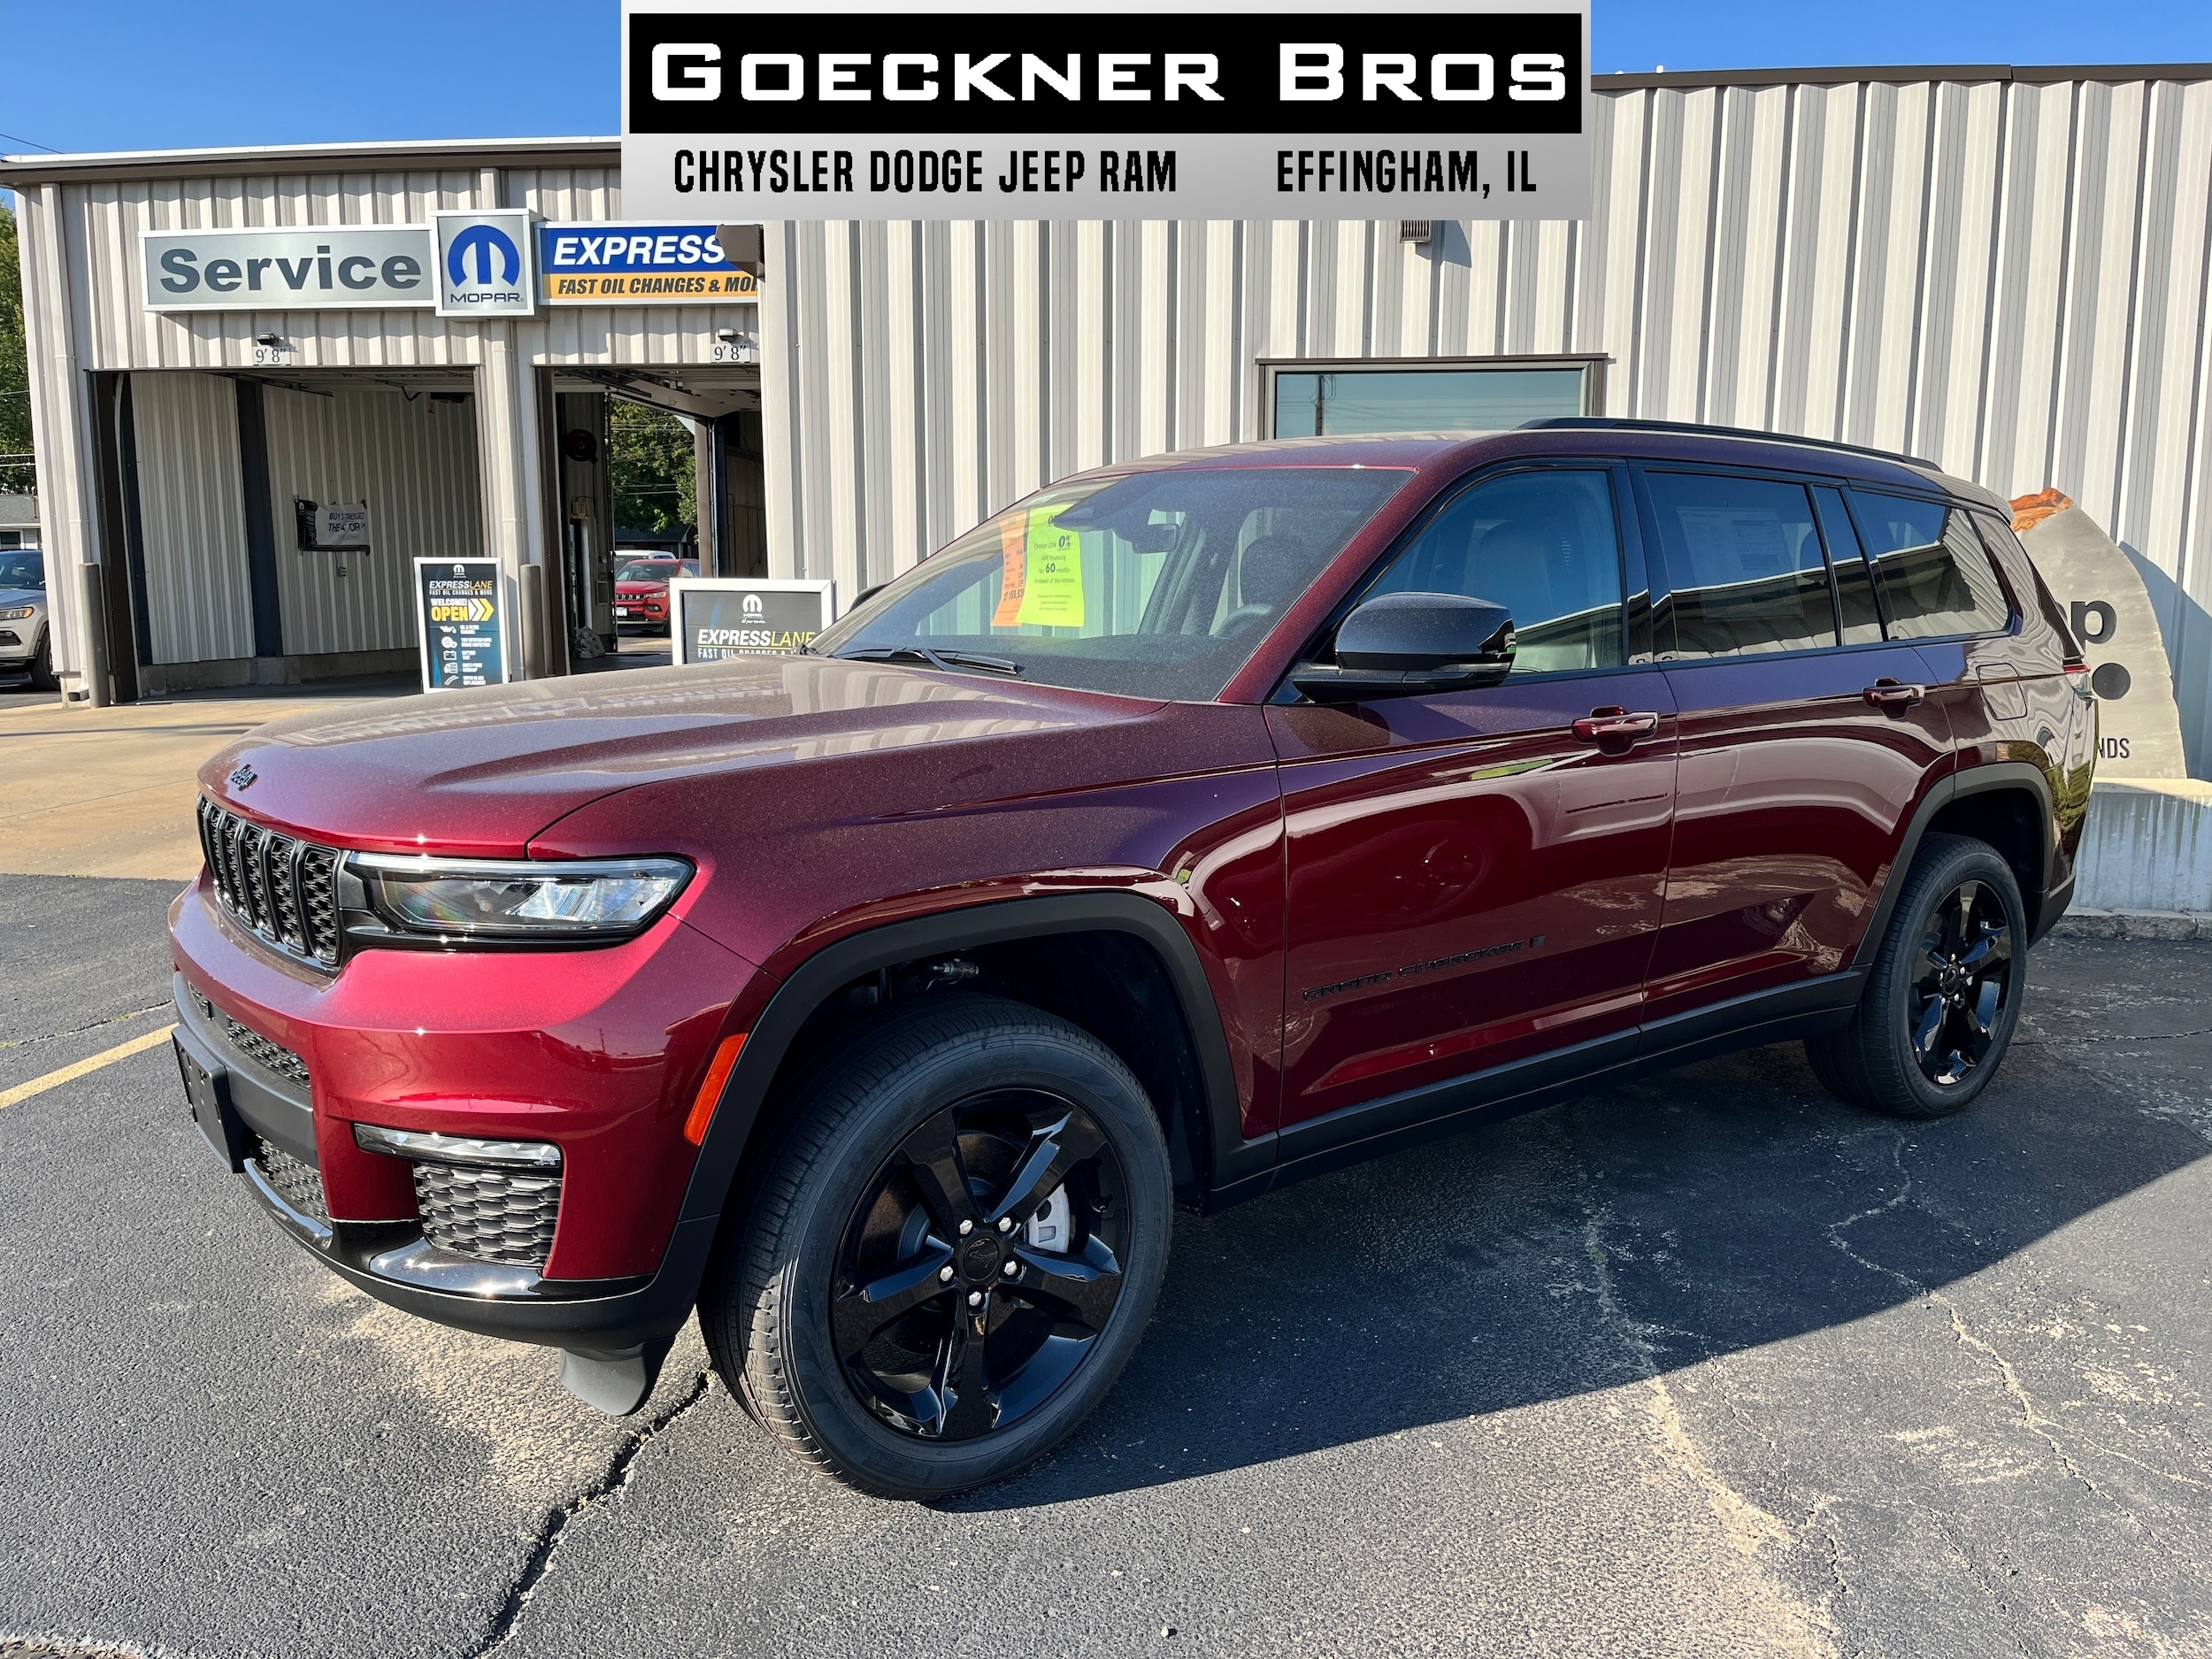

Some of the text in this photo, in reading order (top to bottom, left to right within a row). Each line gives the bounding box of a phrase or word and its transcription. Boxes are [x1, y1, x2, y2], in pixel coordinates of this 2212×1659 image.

[553, 234, 726, 265] EXPRESS
[160, 245, 422, 293] Service
[558, 279, 597, 295] FAST
[601, 278, 625, 294] OIL
[628, 276, 705, 294] CHANGES
[709, 279, 720, 292] &
[450, 293, 520, 303] MOPAR
[1045, 563, 1056, 573] 60
[432, 606, 468, 621] OPEN
[698, 648, 717, 658] FAST
[1302, 971, 1393, 1002] GRAND
[1398, 940, 1525, 978] CHEROKEE
